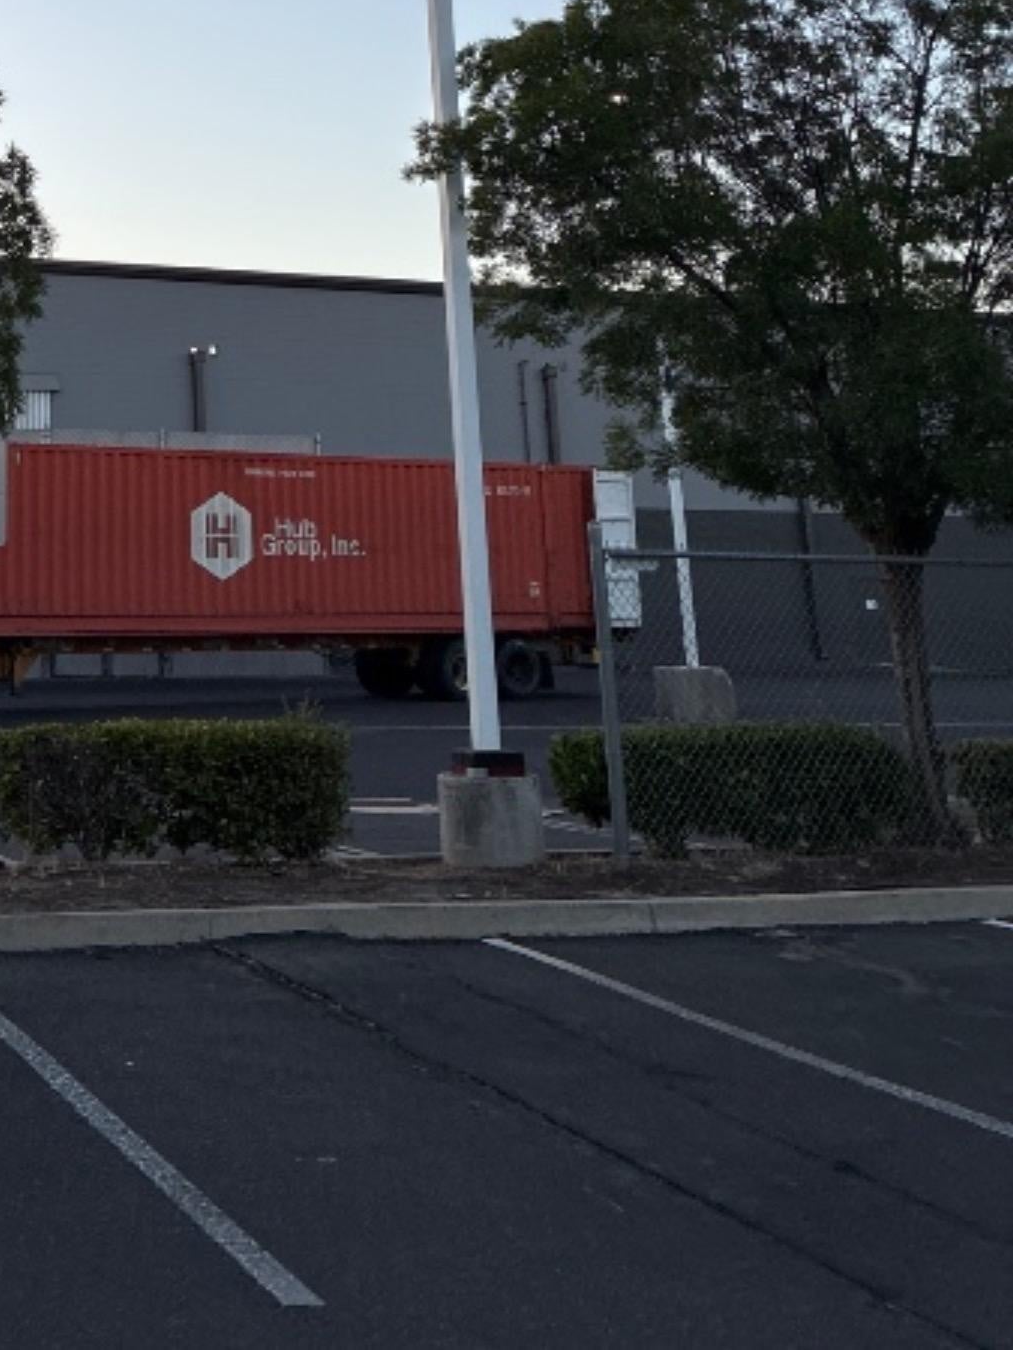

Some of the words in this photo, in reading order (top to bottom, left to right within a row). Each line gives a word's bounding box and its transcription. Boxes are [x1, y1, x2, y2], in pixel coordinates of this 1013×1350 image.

[275, 517, 318, 539] Hub
[261, 533, 328, 562] Group,
[331, 534, 367, 556] Inc.
